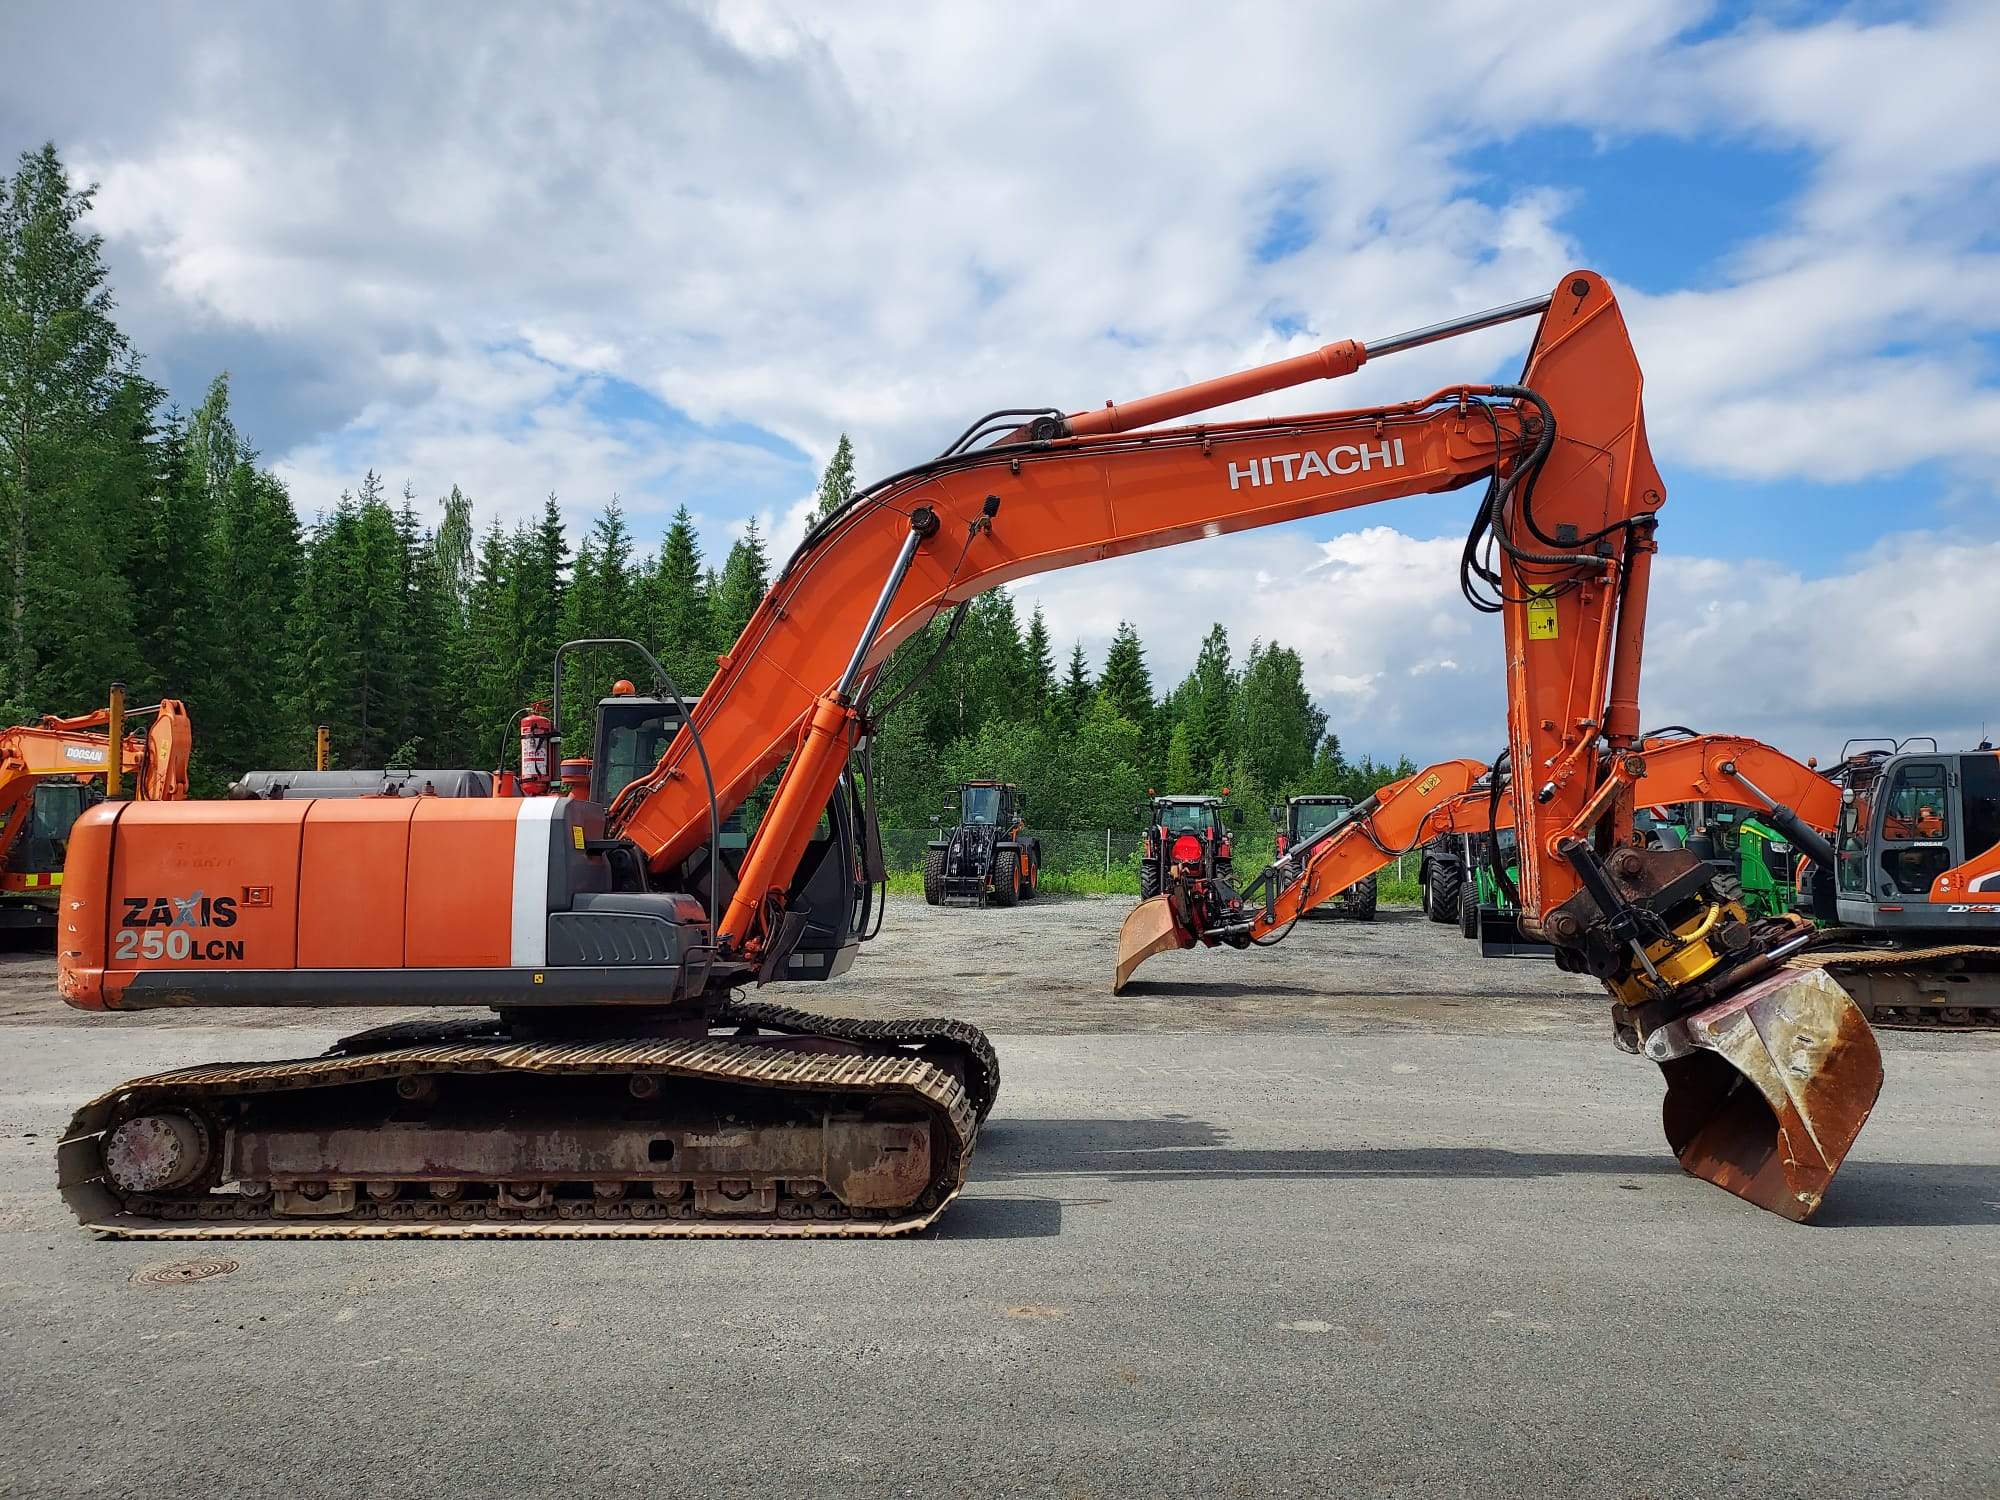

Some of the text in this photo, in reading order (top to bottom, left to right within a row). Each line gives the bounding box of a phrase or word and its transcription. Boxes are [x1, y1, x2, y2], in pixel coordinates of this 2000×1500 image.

[1228, 438, 1405, 490] HITACHI
[66, 747, 103, 762] DOOSAN
[122, 889, 238, 928] ZAXIS
